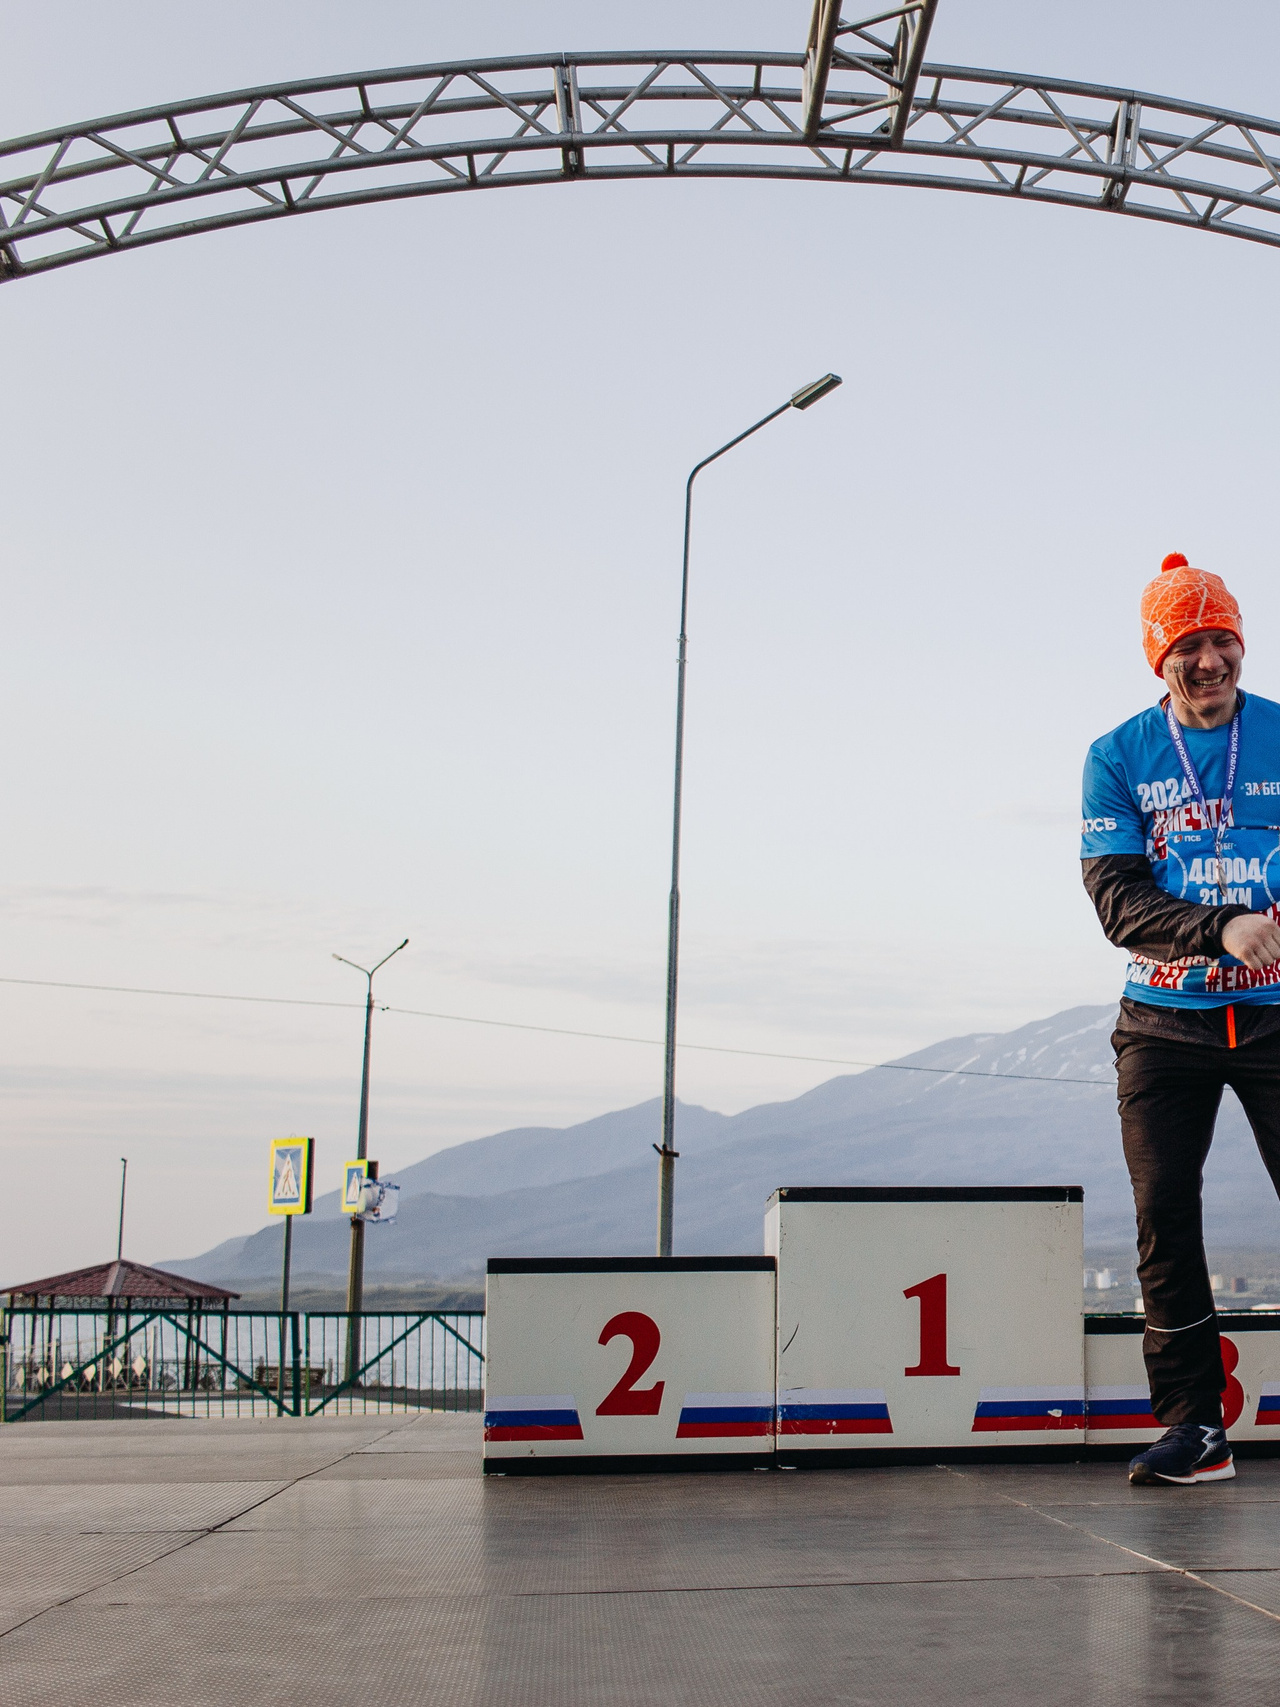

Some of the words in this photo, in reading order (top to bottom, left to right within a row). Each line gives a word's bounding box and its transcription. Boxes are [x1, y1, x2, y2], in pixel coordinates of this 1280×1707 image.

[1175, 739, 1200, 795] САХАЛИНСКАЯ
[1227, 753, 1237, 790] ОБЛАСТЬ
[1137, 777, 1193, 813] 2024
[1086, 817, 1118, 833] ПСБ
[1184, 834, 1202, 842] ПСБ
[1188, 857, 1264, 885] 40004
[902, 1272, 961, 1378] 1
[595, 1311, 666, 1417] 2
